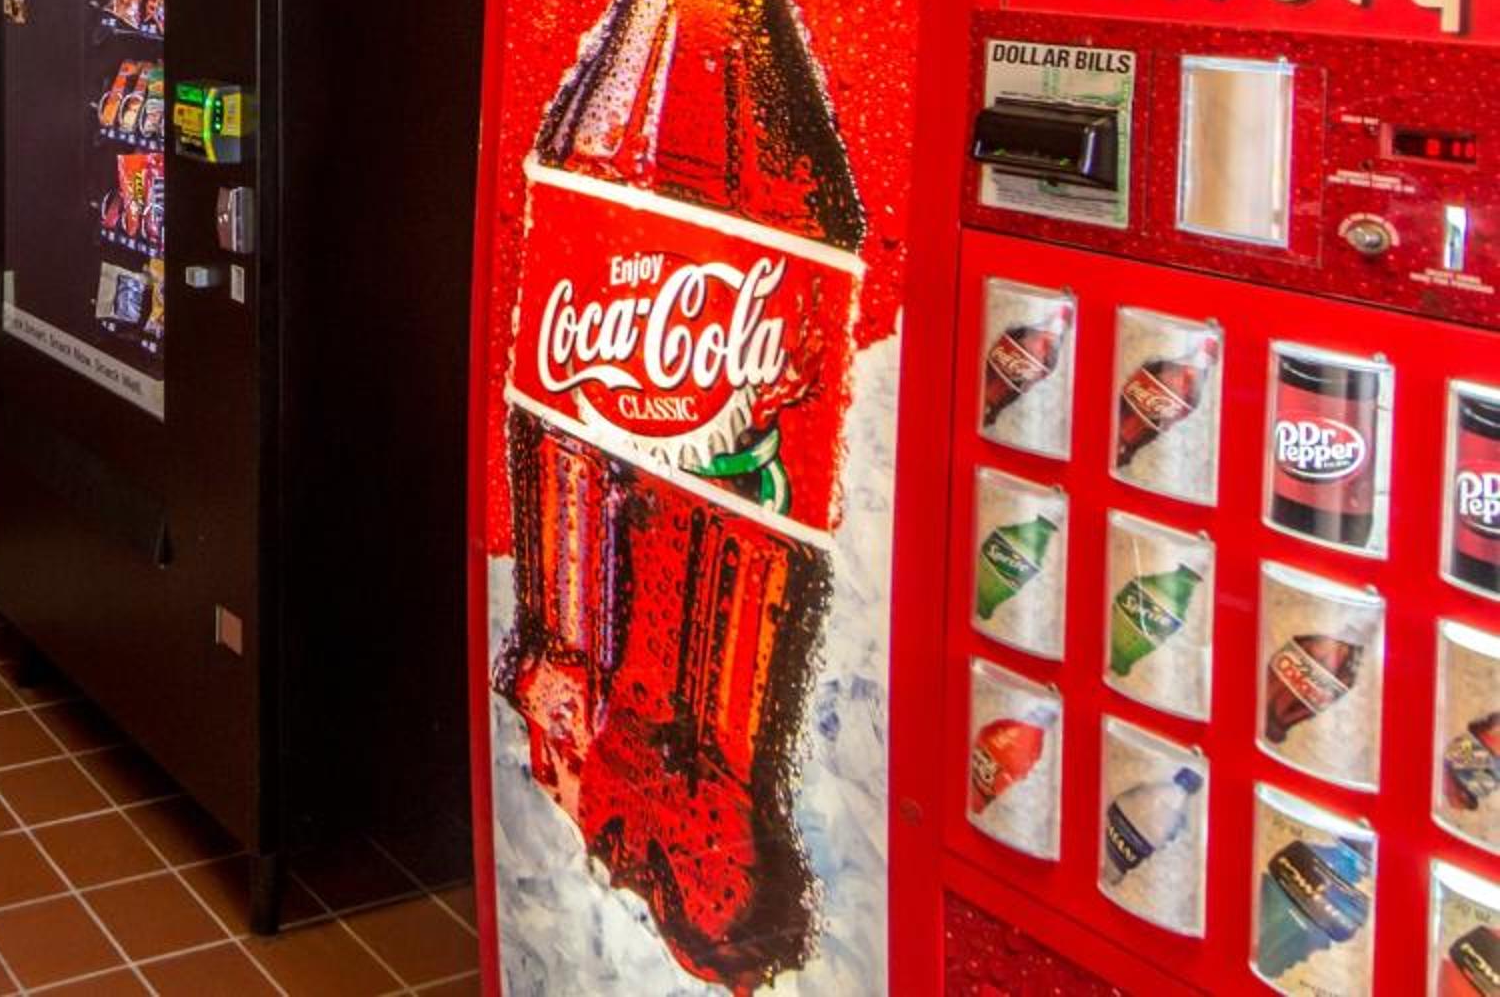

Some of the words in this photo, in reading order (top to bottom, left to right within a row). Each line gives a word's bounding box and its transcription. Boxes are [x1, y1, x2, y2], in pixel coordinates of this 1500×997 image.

[992, 44, 1070, 69] DOLLAR
[1074, 51, 1132, 74] BILLS
[610, 252, 665, 289] Enjoy
[537, 256, 787, 393] Coca-Cola
[618, 394, 699, 422] CLASSIC
[1275, 420, 1362, 469] Pepper
